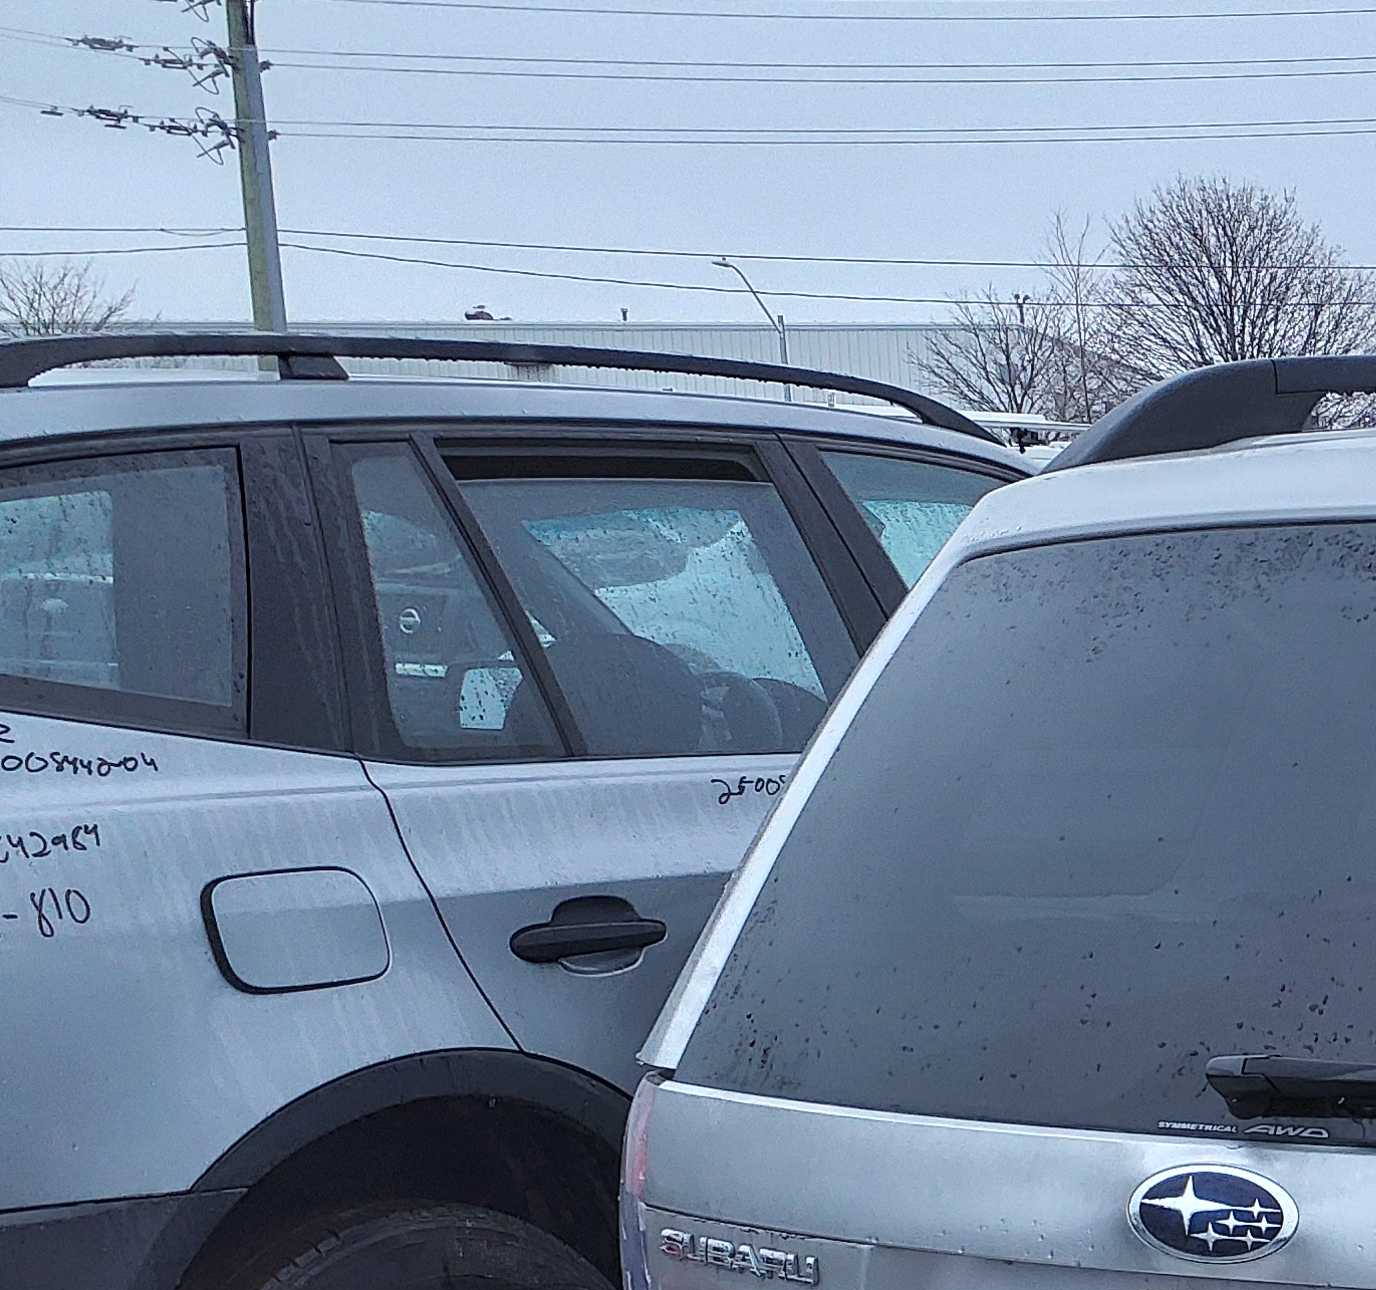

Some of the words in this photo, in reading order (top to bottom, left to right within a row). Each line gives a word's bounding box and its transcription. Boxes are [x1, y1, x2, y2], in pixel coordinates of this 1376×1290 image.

[1157, 1119, 1238, 1134] SYMMETRICAL
[1244, 1124, 1330, 1139] AWD
[660, 1227, 820, 1287] SUBARU
